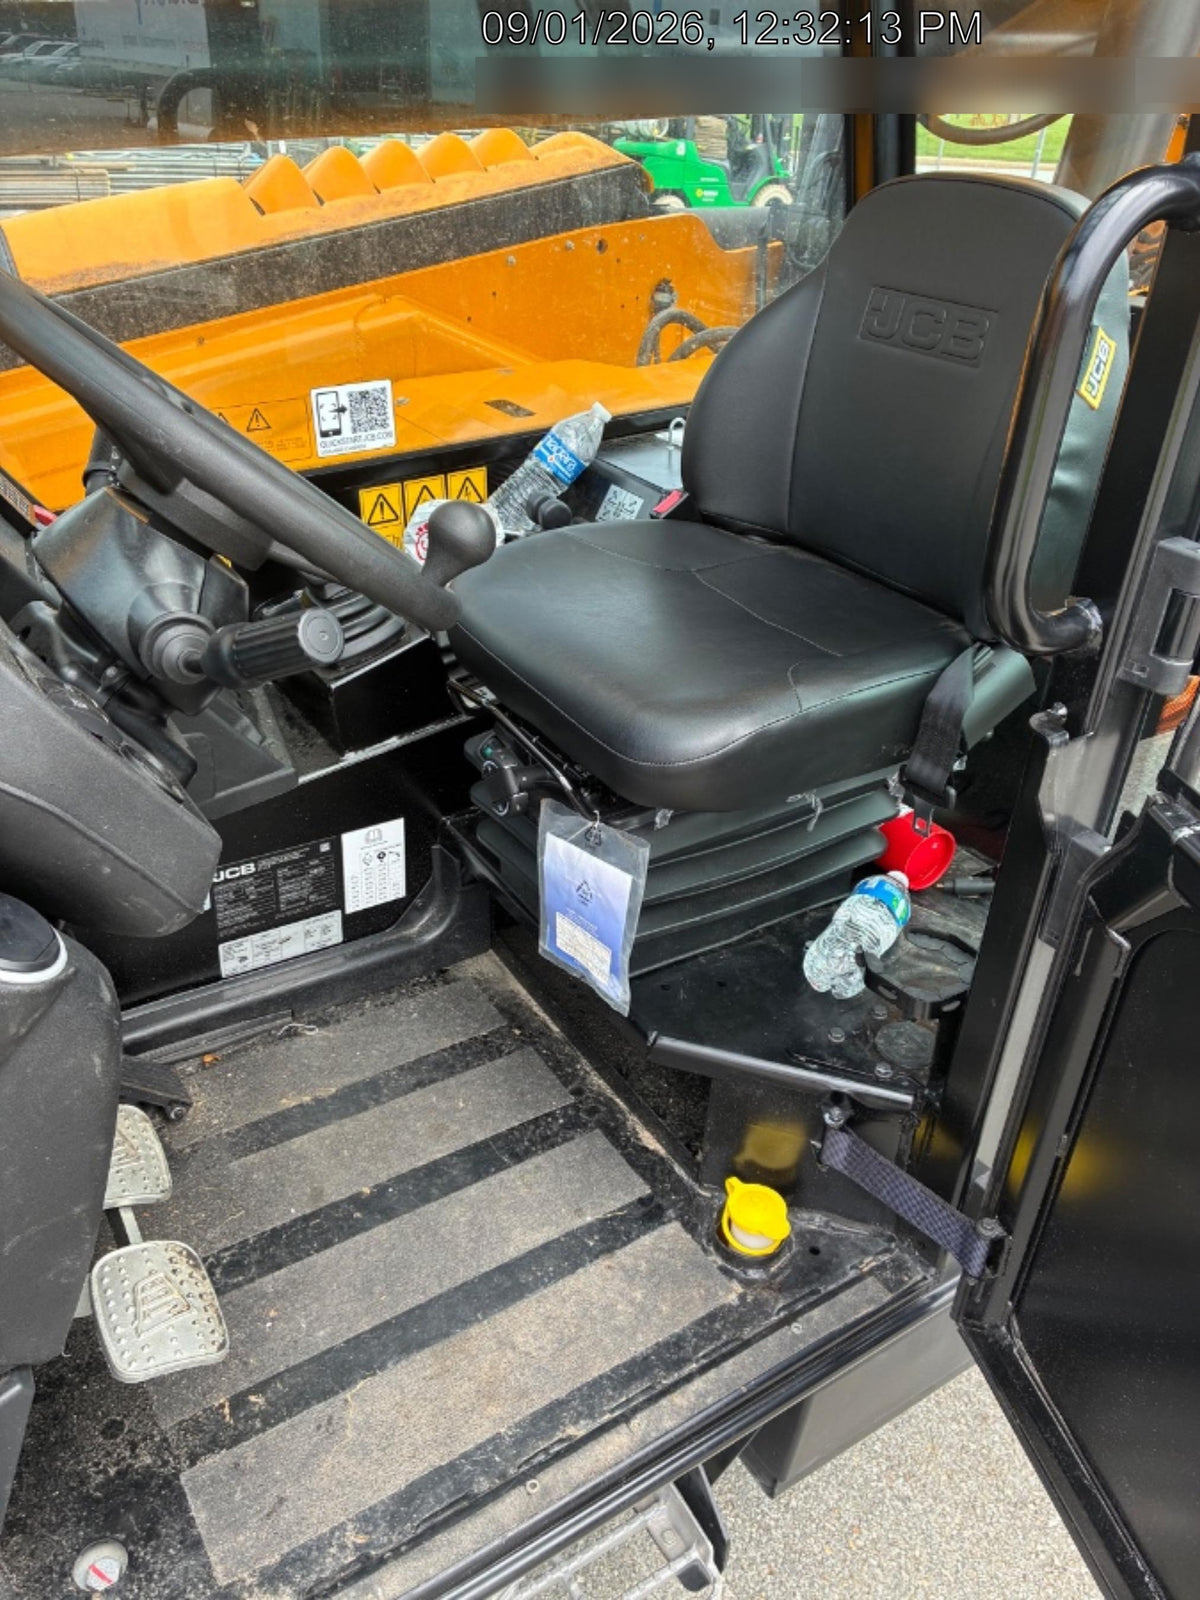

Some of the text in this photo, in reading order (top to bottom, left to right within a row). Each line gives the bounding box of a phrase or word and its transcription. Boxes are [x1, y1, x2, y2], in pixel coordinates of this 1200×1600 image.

[863, 291, 991, 361] JCB
[1086, 339, 1110, 397] JCB
[212, 862, 257, 883] JCB
